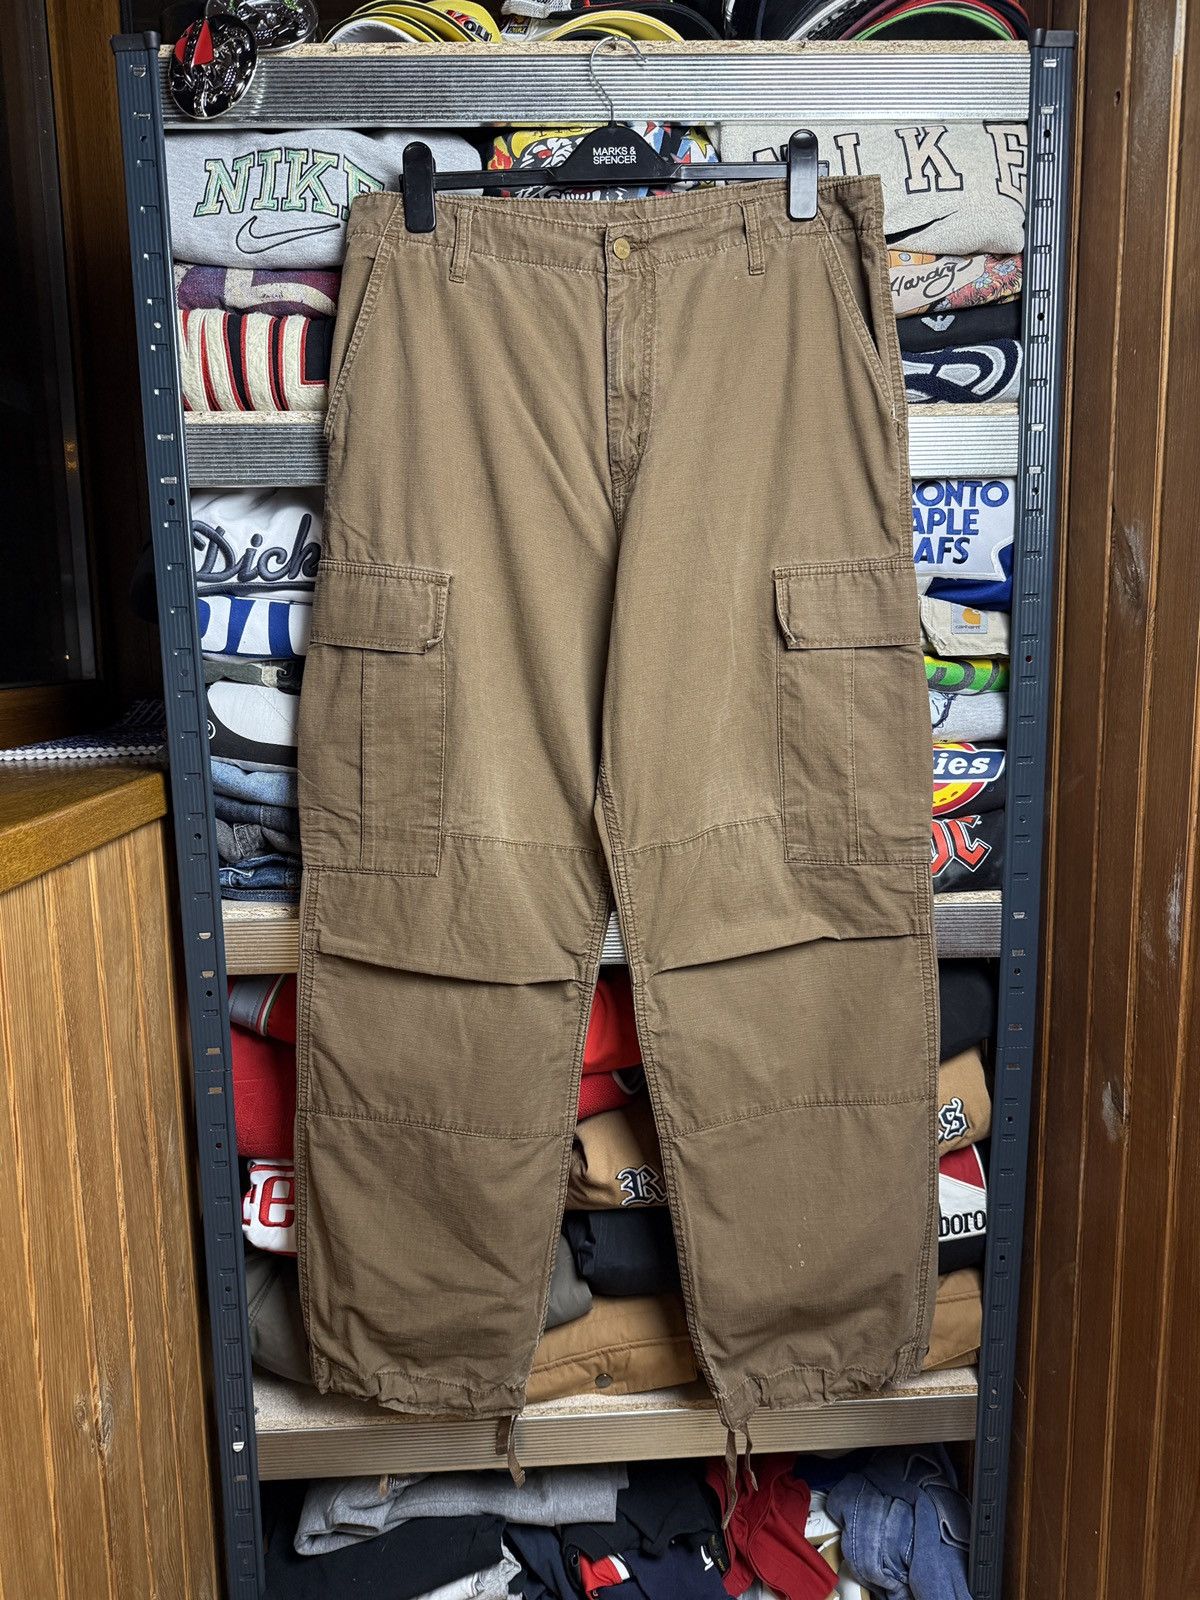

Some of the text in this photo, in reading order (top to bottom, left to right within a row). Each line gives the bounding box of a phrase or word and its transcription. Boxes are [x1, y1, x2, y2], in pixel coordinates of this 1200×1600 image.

[592, 146, 636, 156] MARKS &
[592, 155, 637, 165] SPENCER
[753, 120, 1027, 213] IKE
[912, 480, 1010, 508] ONTO
[912, 507, 980, 536] APLE
[192, 513, 322, 584] Dick
[913, 536, 971, 565] AFS
[938, 1209, 986, 1238] boro
